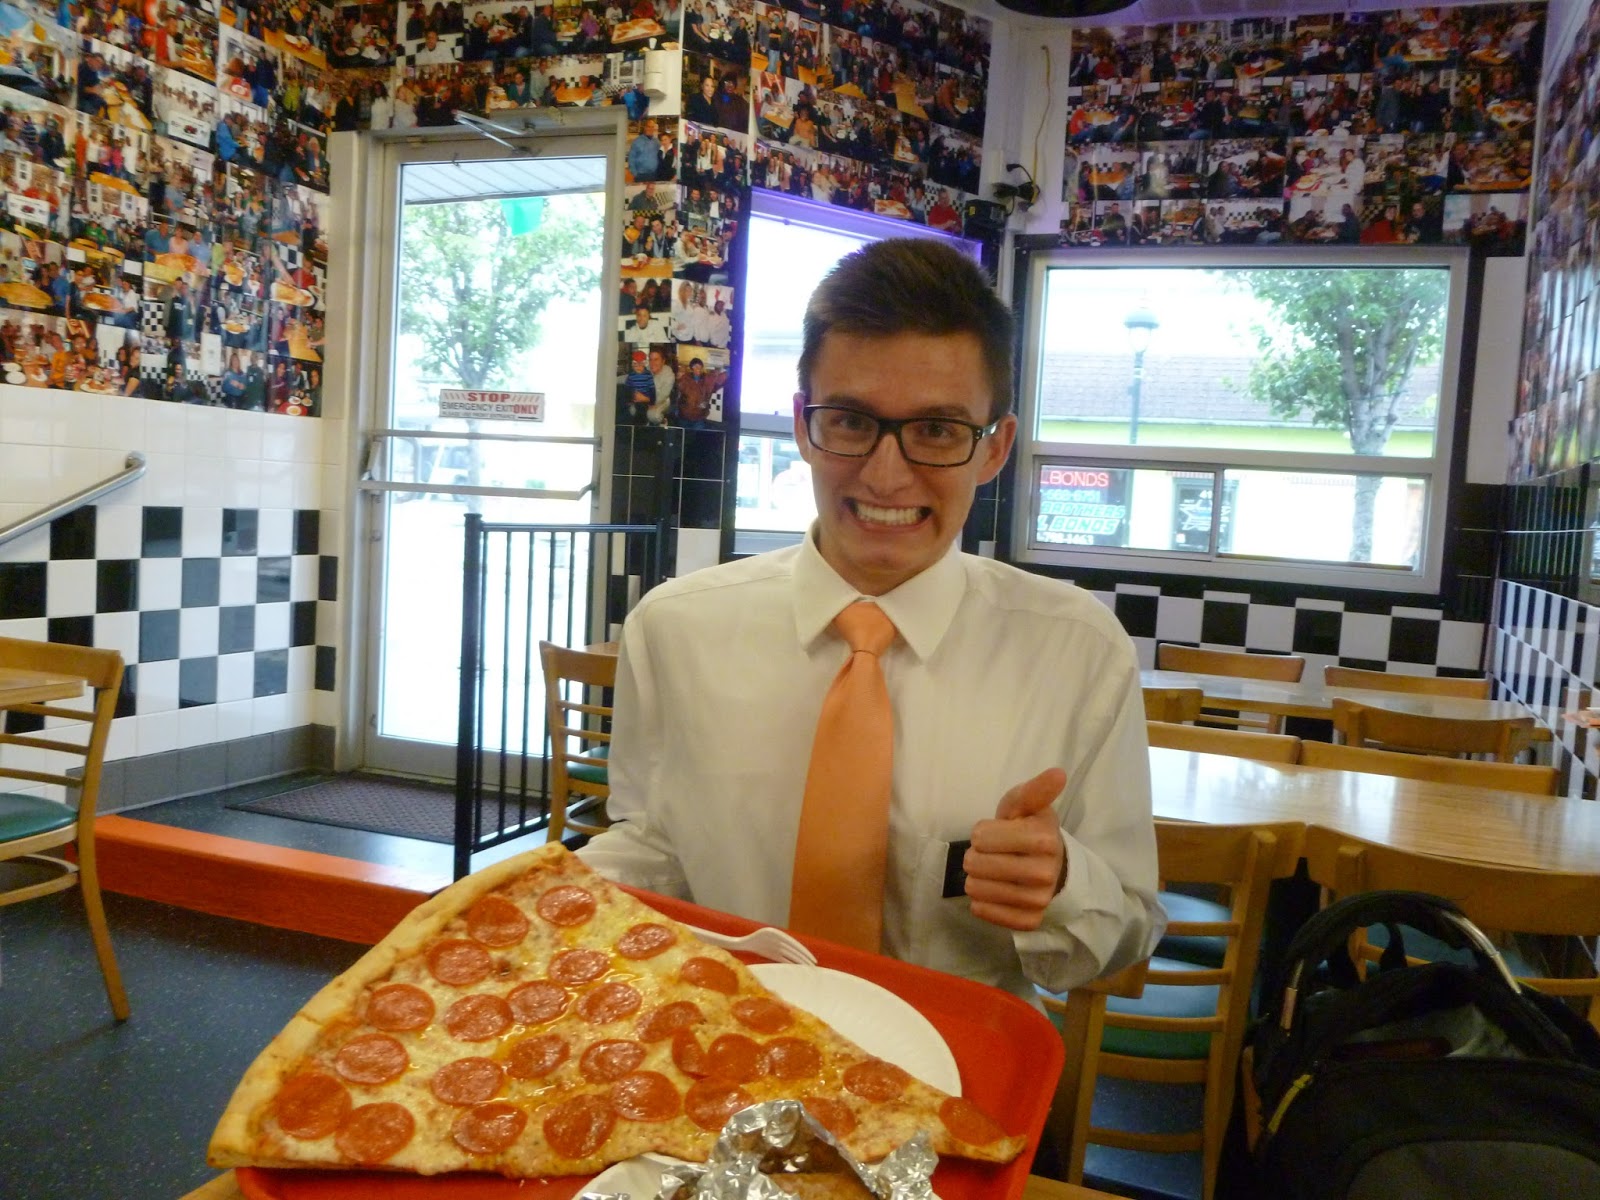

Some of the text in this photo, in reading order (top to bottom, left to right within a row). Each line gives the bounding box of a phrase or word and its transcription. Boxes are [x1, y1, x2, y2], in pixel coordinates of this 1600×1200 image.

[467, 392, 511, 402] STOP
[441, 401, 539, 414] EMERGENCY EXIT ONLY
[1049, 470, 1109, 487] BONDS
[1049, 516, 1120, 535] BONDS
